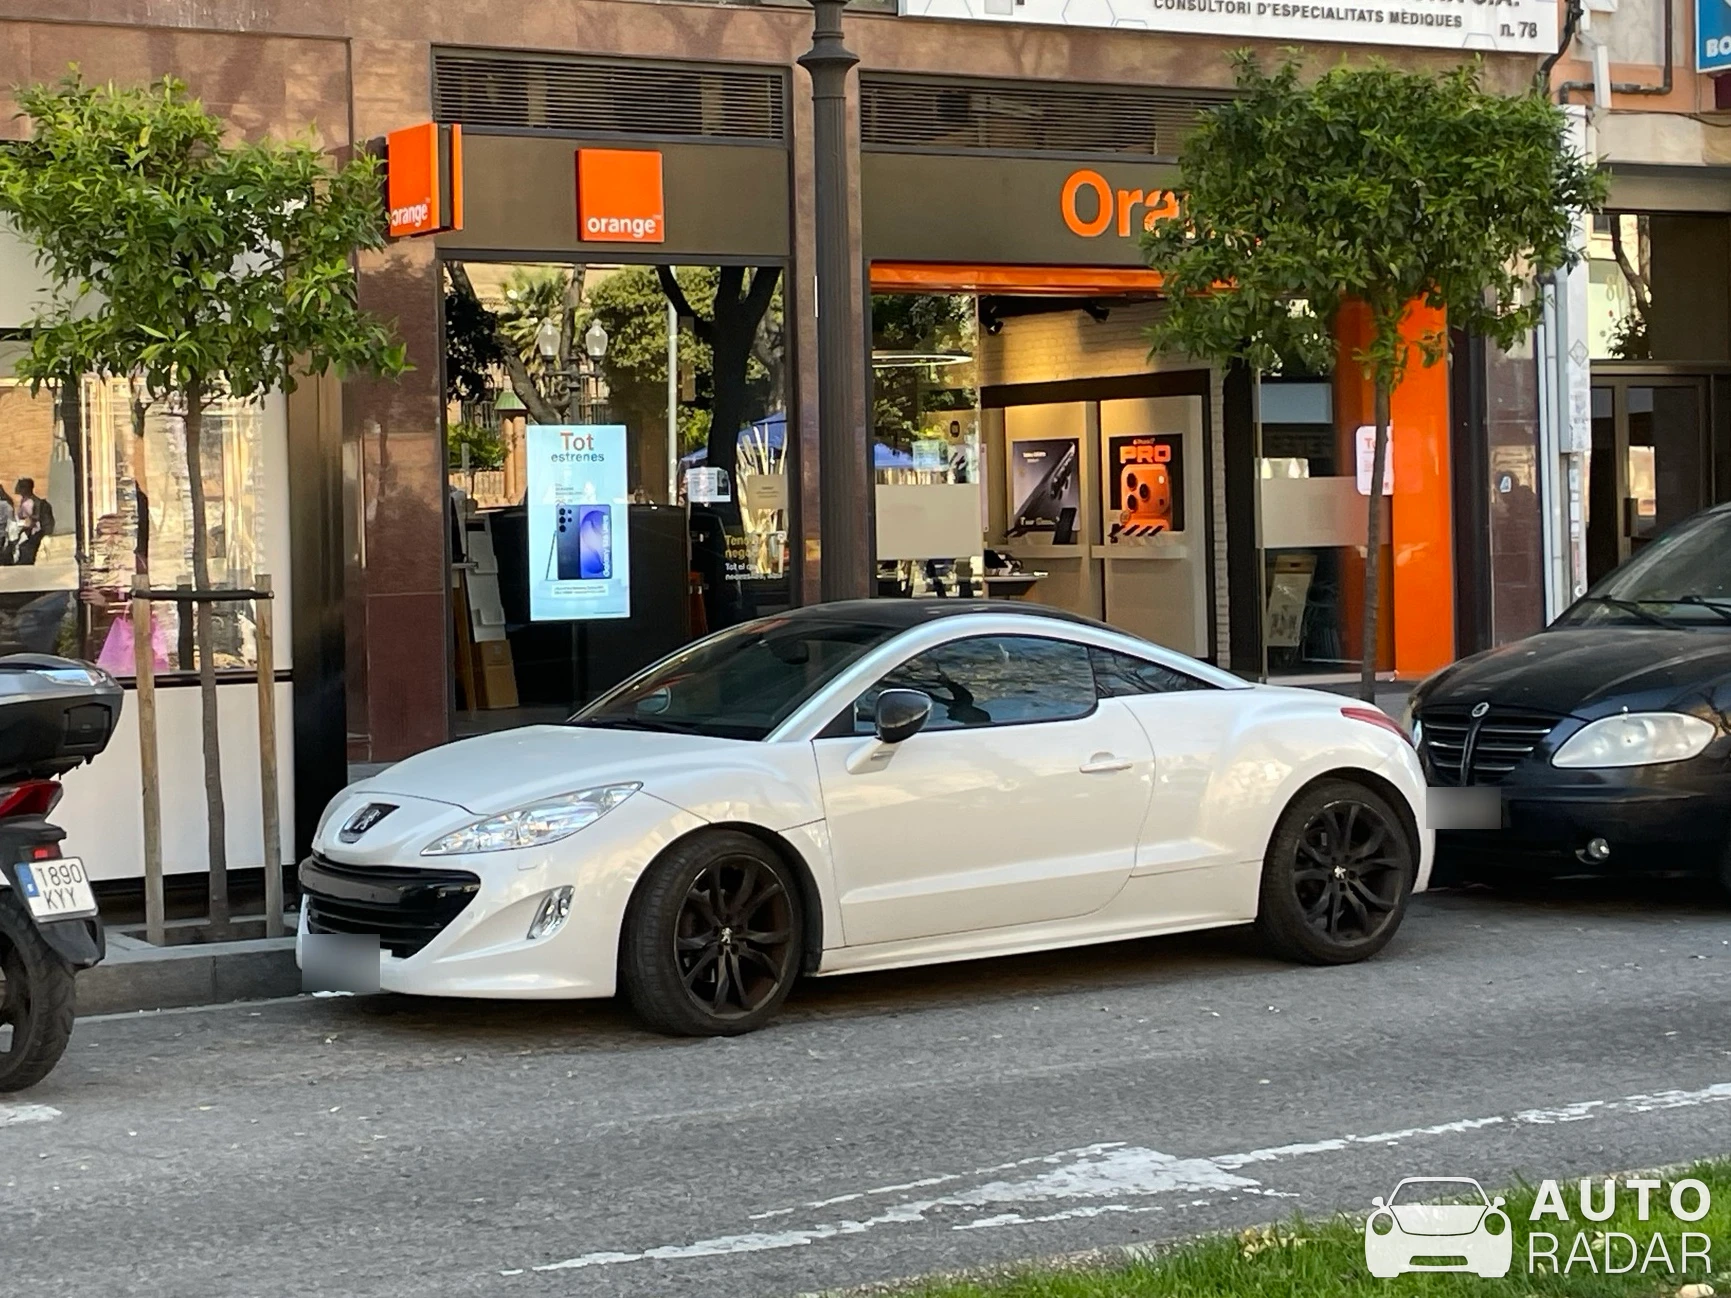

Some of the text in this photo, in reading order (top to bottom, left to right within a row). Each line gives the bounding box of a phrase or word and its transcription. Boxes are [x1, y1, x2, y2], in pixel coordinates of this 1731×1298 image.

[1154, 0, 1250, 14] CONSULTORI
[1257, 3, 1384, 22] D'ESPECIALITATS
[390, 203, 428, 228] orange
[587, 216, 657, 239] orange
[560, 432, 595, 451] Tot
[551, 452, 605, 462] estrenes
[1119, 444, 1172, 464] PRO
[35, 863, 83, 888] 1890
[43, 887, 76, 910] KYY
